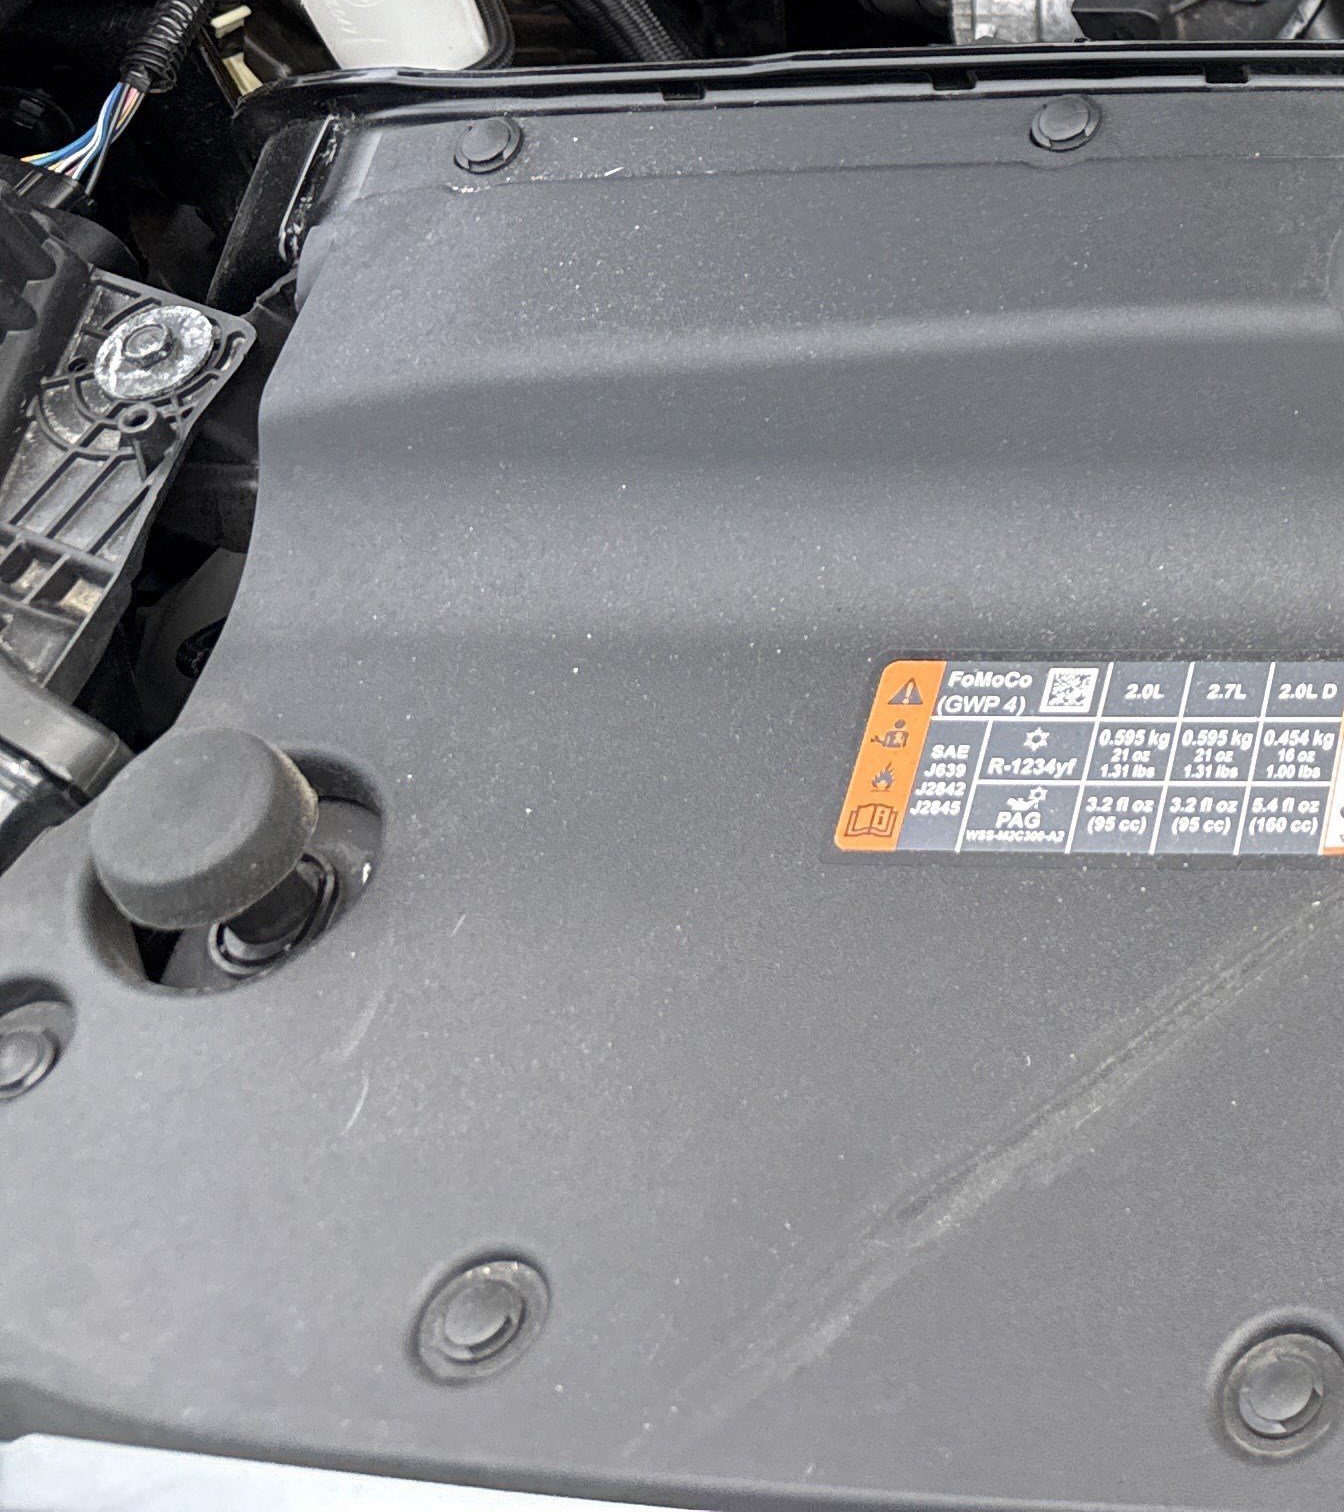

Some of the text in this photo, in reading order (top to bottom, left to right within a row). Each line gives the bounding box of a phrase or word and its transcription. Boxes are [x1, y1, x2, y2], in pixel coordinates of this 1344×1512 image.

[948, 671, 1033, 688] FoMoCo
[1124, 683, 1165, 700] 2.0L
[1206, 684, 1247, 701] 2.7L
[1277, 683, 1338, 700] 2.0L D
[937, 695, 1026, 717] (GWP 4)
[1099, 728, 1171, 750] 0.595 kg
[1182, 729, 1253, 751] 0.595 kg
[1263, 729, 1336, 751] 0.454 kg
[931, 744, 970, 759] SAE
[1111, 748, 1151, 762] 21 oz
[1193, 748, 1234, 763] 21 oz
[1277, 749, 1316, 762] 16 oz
[924, 763, 967, 778] J639
[988, 758, 1078, 779] R-1234yf
[1100, 764, 1155, 778] 1.31 lbs
[1183, 764, 1239, 778] 1.31 lbs
[1266, 765, 1321, 778] 1.00 lbs
[1086, 797, 1155, 813] 3.2 fl oz
[1169, 797, 1239, 813] 3.2 fl oz
[1252, 797, 1320, 813] 5.4 fl oz
[995, 812, 1041, 829] PAG
[1087, 816, 1148, 835] (95 cc)
[1171, 816, 1232, 835] (95 cc)
[1249, 816, 1319, 836] (160 cc)
